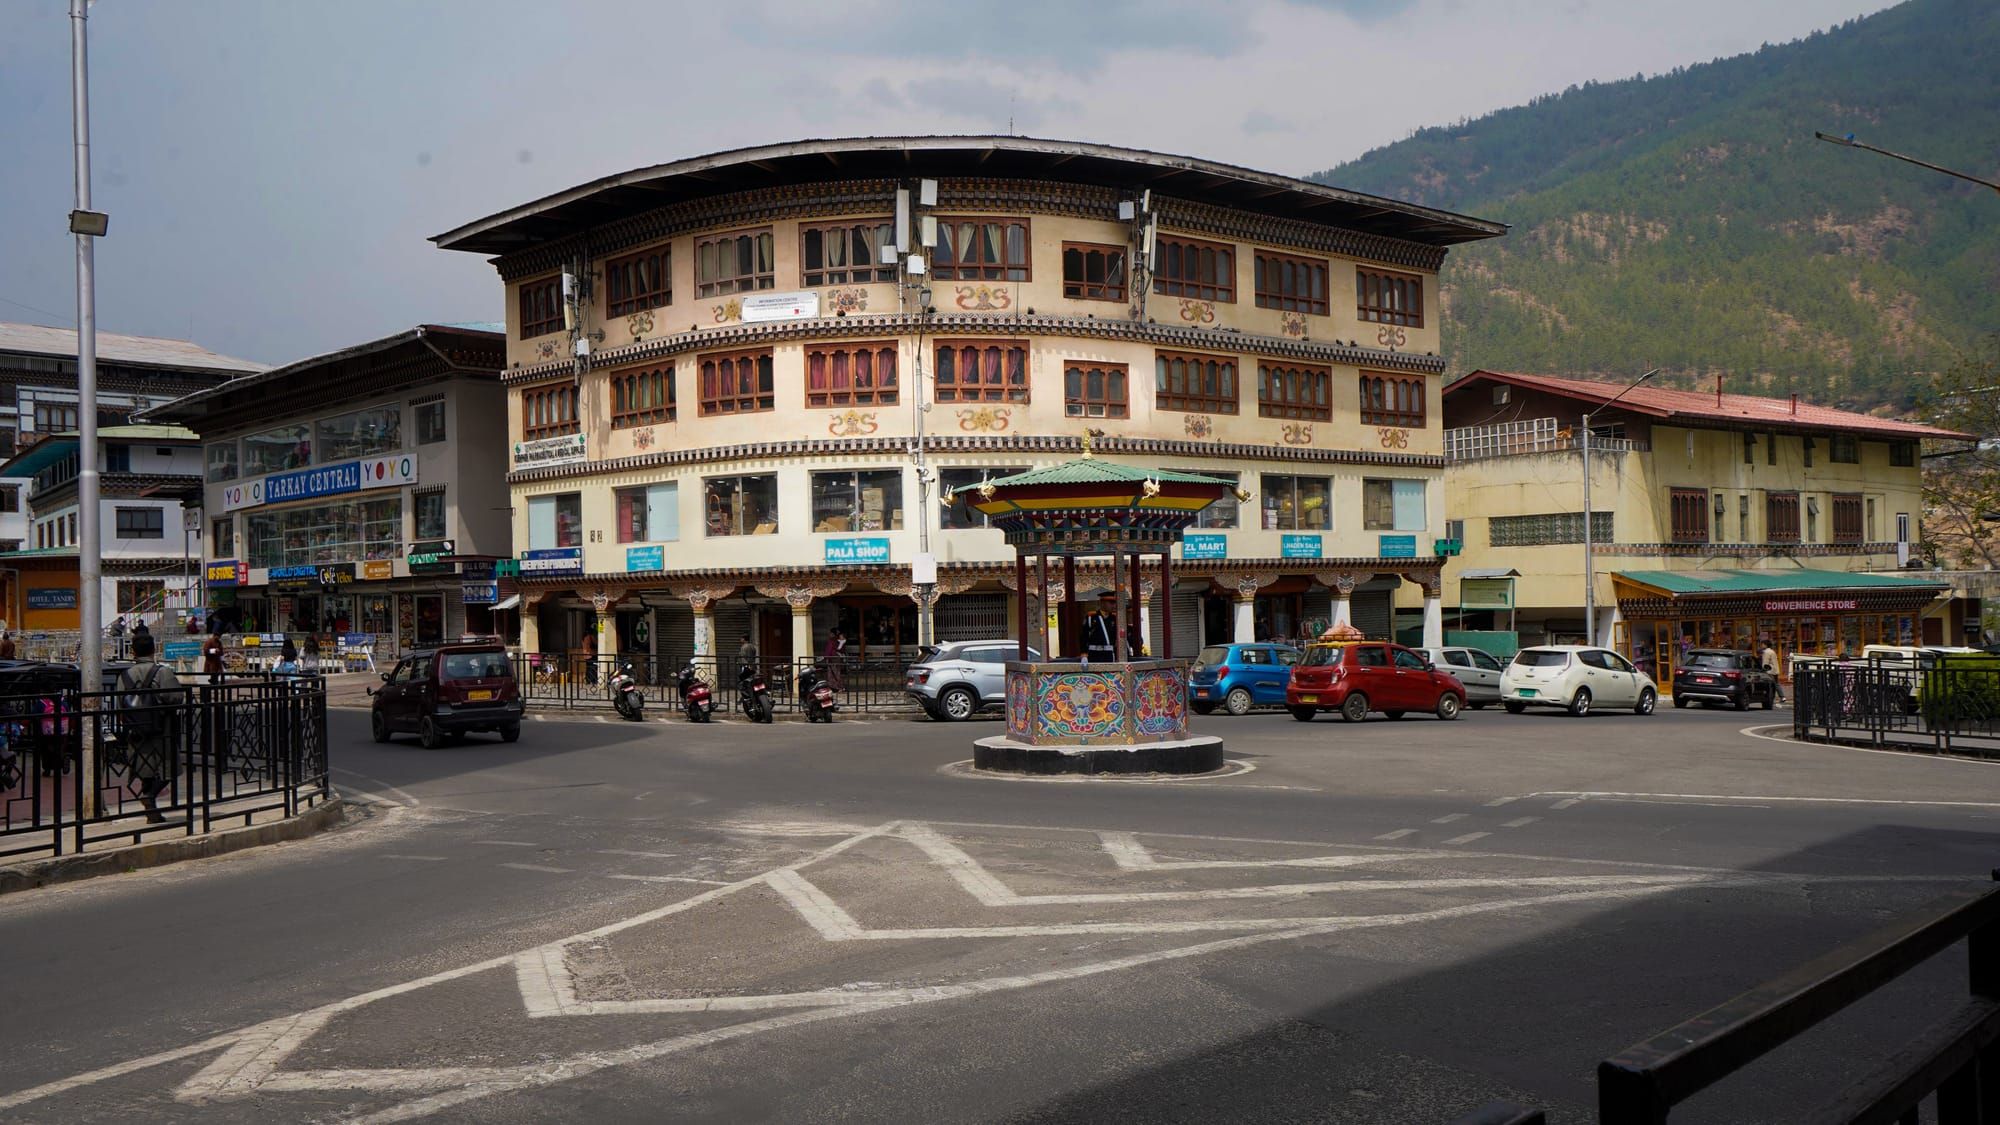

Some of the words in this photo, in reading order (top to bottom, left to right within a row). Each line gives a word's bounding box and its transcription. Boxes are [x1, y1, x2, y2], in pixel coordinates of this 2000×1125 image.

[268, 474, 307, 498] YARKAY
[309, 466, 357, 493] CENTRAL
[1184, 543, 1197, 551] ZL
[1198, 542, 1225, 551] MART
[827, 547, 854, 558] PALA
[856, 546, 887, 558] SHOP
[28, 595, 50, 603] HOTEL
[1765, 600, 1826, 610] CONVENIENCE
[1827, 600, 1856, 609] STORE
